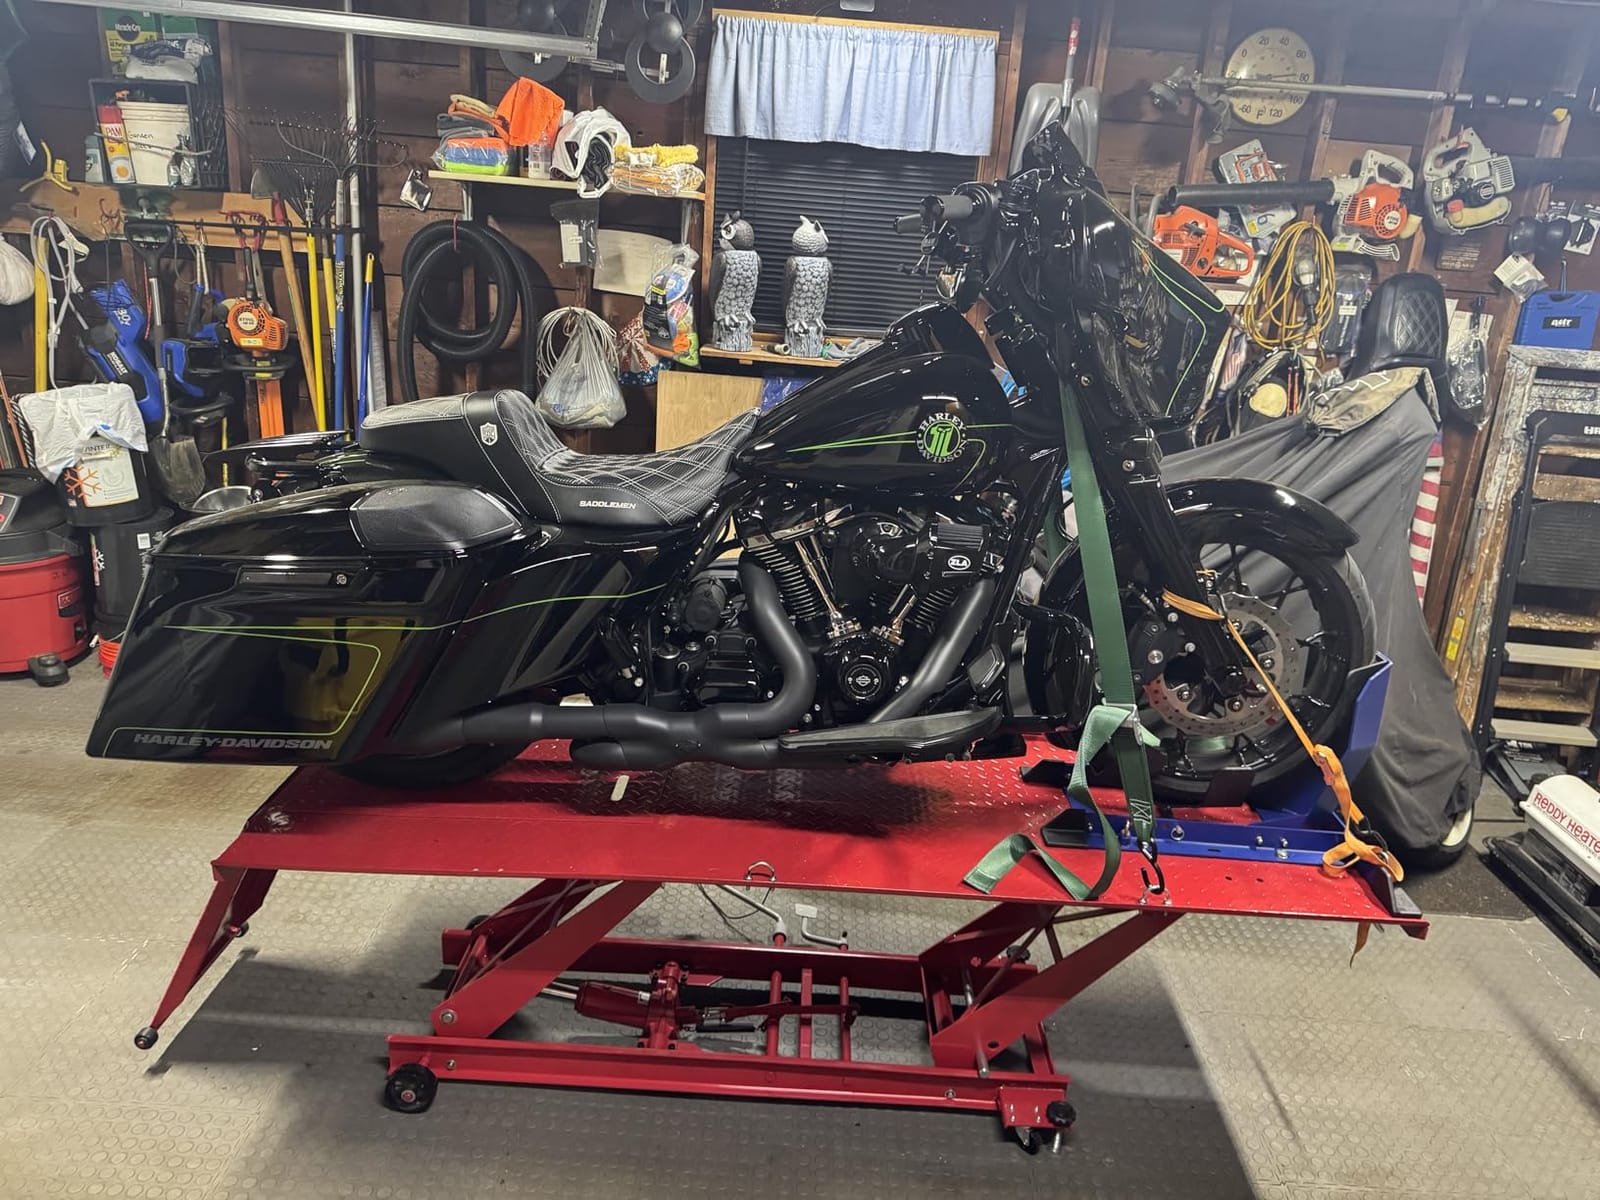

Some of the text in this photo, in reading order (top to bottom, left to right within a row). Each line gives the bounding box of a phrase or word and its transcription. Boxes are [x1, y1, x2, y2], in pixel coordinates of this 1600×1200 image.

[1259, 35, 1290, 46] 20 40
[918, 412, 967, 432] HARLEY
[916, 439, 968, 464] DAVIDSON
[579, 500, 637, 509] SADDLEMEN
[133, 733, 333, 750] HARLEY-DAVIDSON
